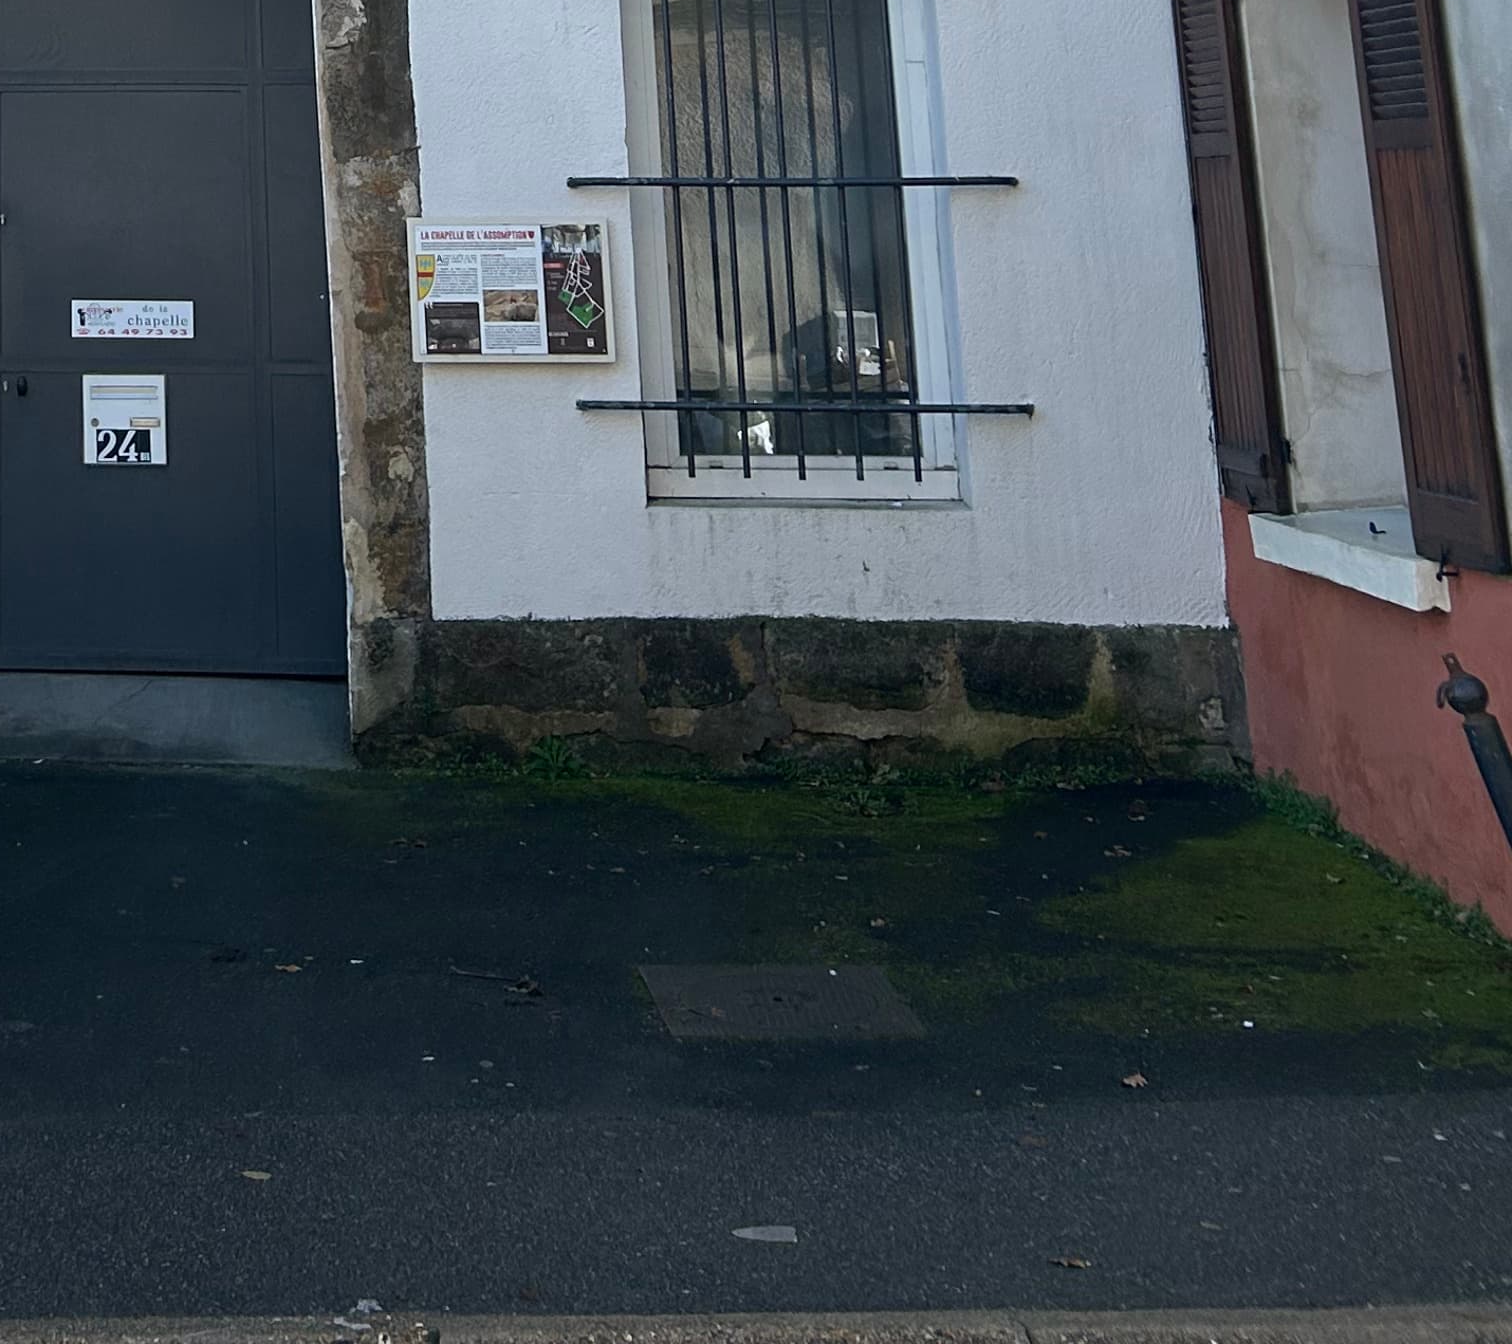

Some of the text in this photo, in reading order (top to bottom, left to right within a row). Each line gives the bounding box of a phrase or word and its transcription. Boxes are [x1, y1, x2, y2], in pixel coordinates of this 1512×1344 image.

[420, 230, 527, 241] LA CHAPELLE DE L'ASSOMPTION
[127, 314, 189, 328] chapelle
[97, 328, 188, 336] 64 49 73 93
[97, 429, 139, 462] 24
